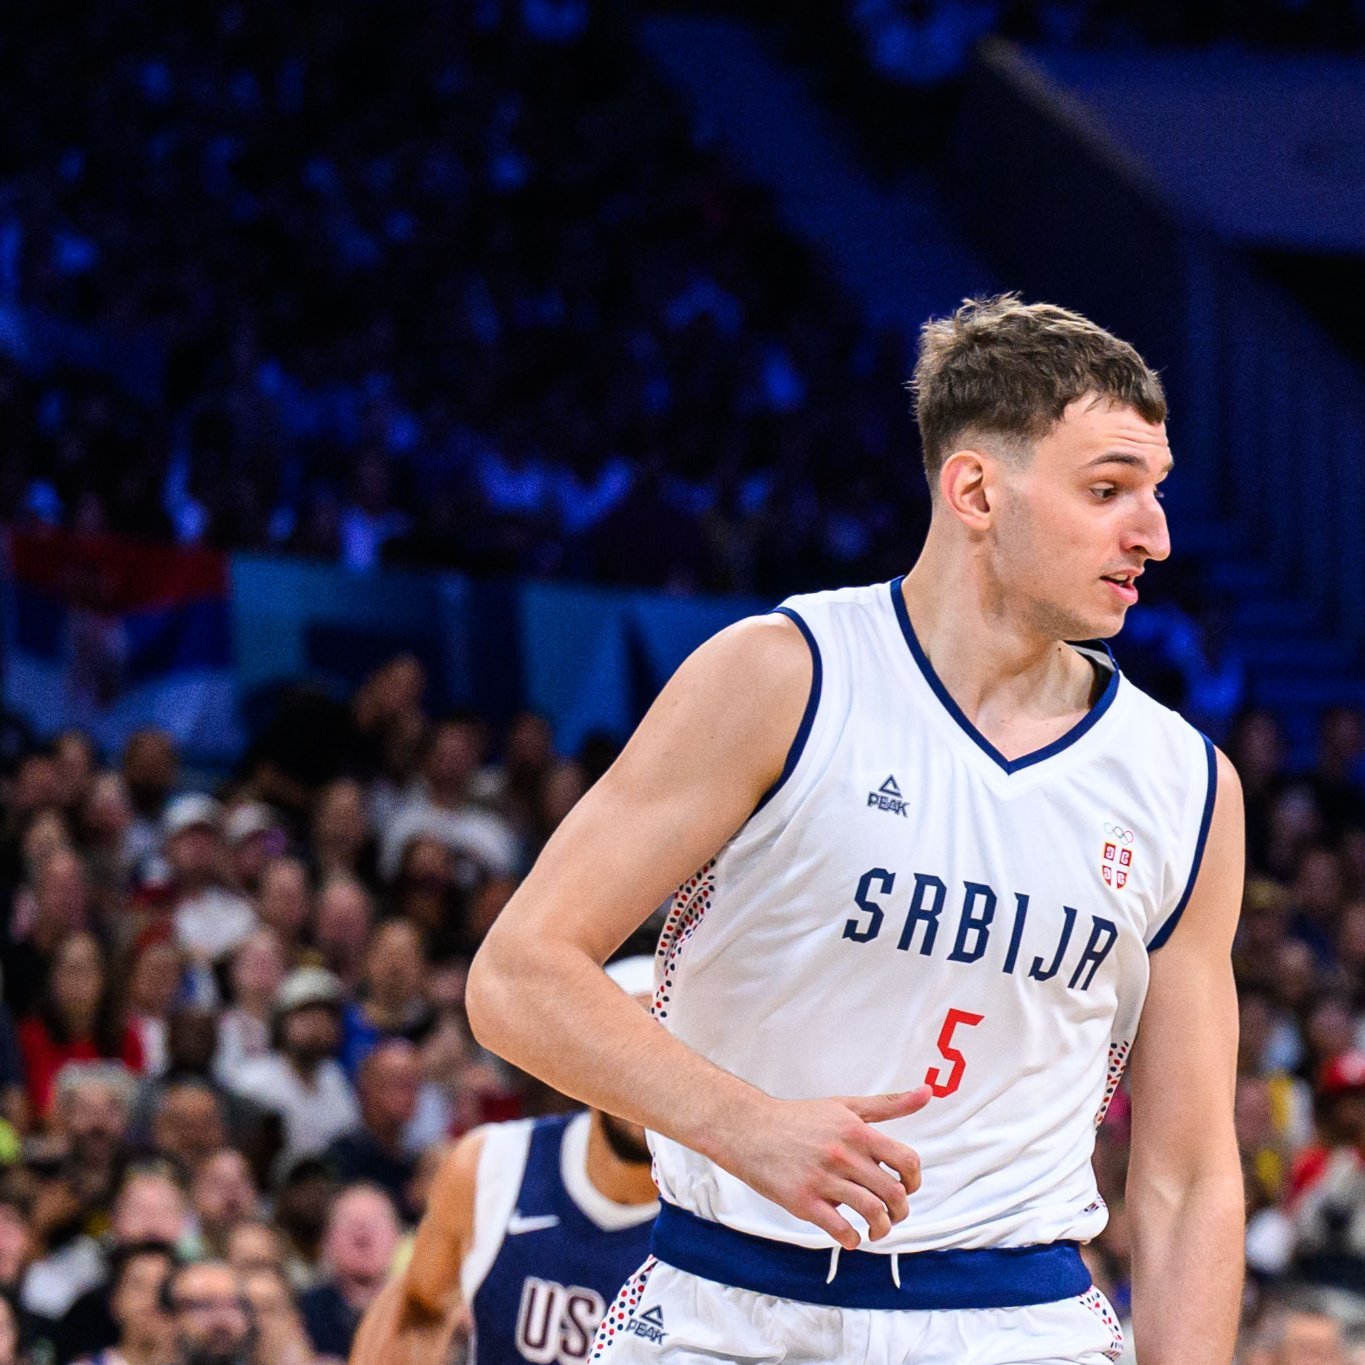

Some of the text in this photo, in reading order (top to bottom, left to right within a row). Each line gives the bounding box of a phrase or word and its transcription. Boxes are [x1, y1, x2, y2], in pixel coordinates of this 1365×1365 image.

[867, 791, 911, 818] PEAK
[842, 867, 1118, 991] SRBIJA
[924, 1008, 985, 1098] 5
[625, 1318, 670, 1346] PEAK
